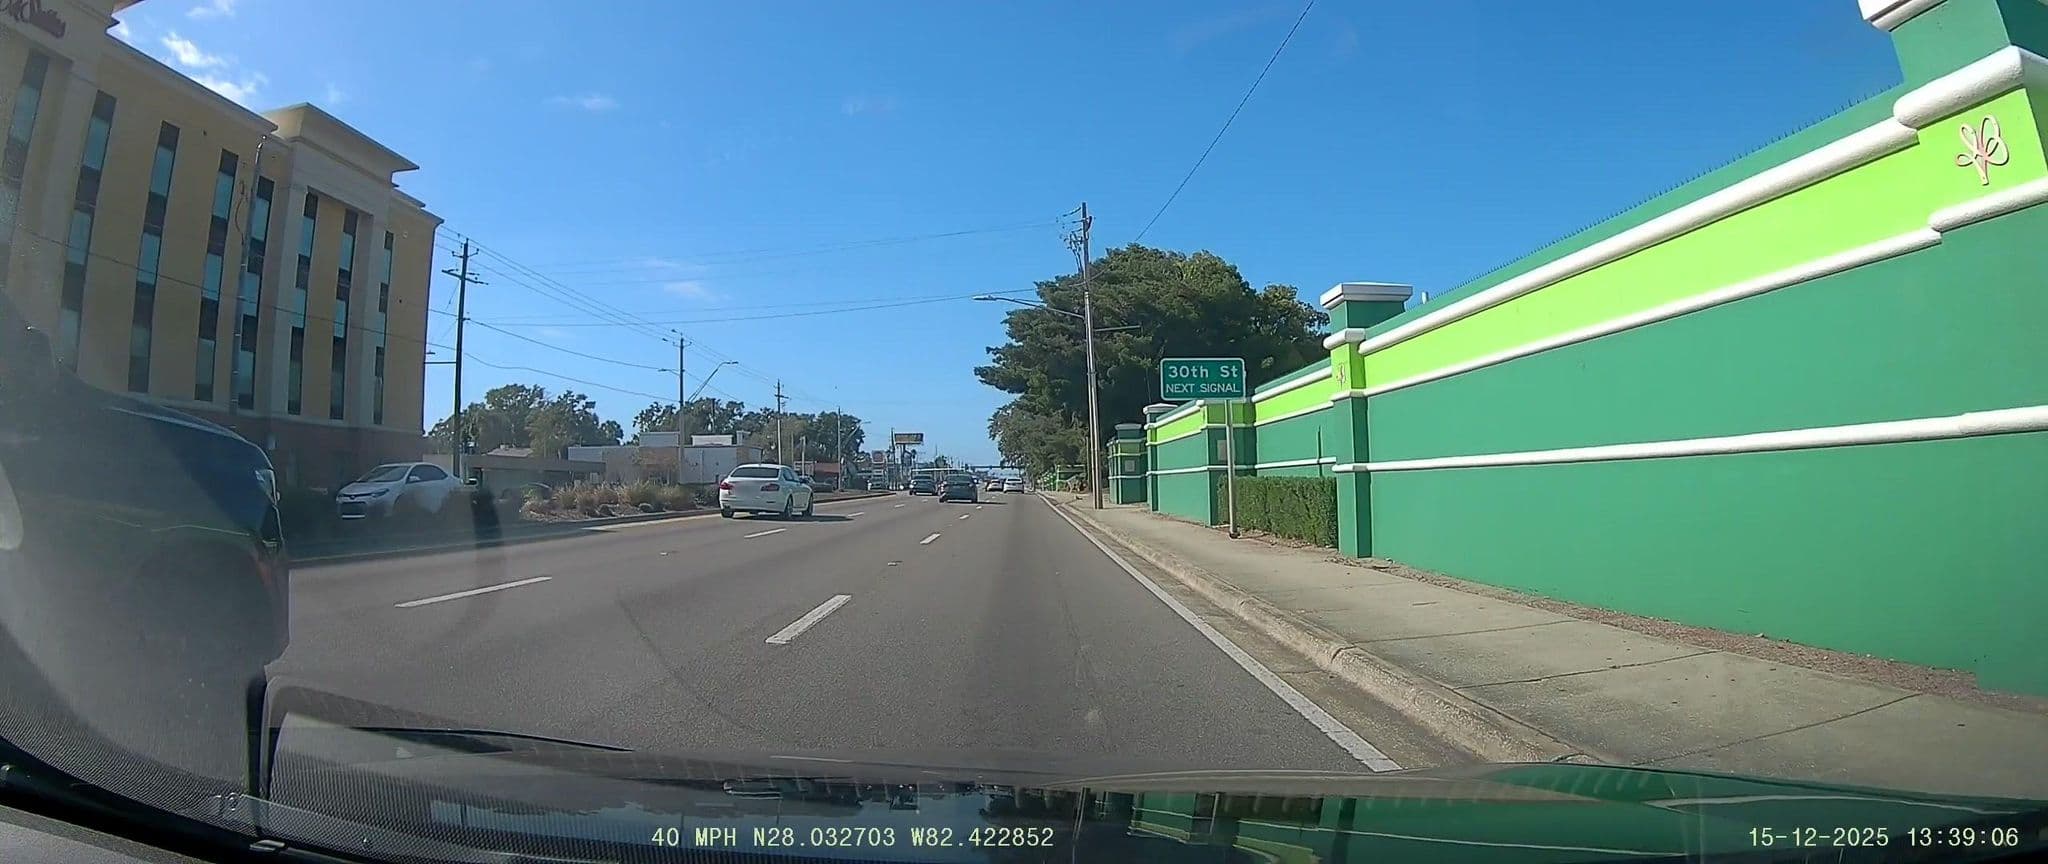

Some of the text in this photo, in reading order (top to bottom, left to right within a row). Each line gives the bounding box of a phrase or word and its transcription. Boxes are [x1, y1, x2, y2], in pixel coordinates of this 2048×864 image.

[1168, 365, 1239, 378] 30th St
[1166, 384, 1240, 393] NEXT SIGNAL
